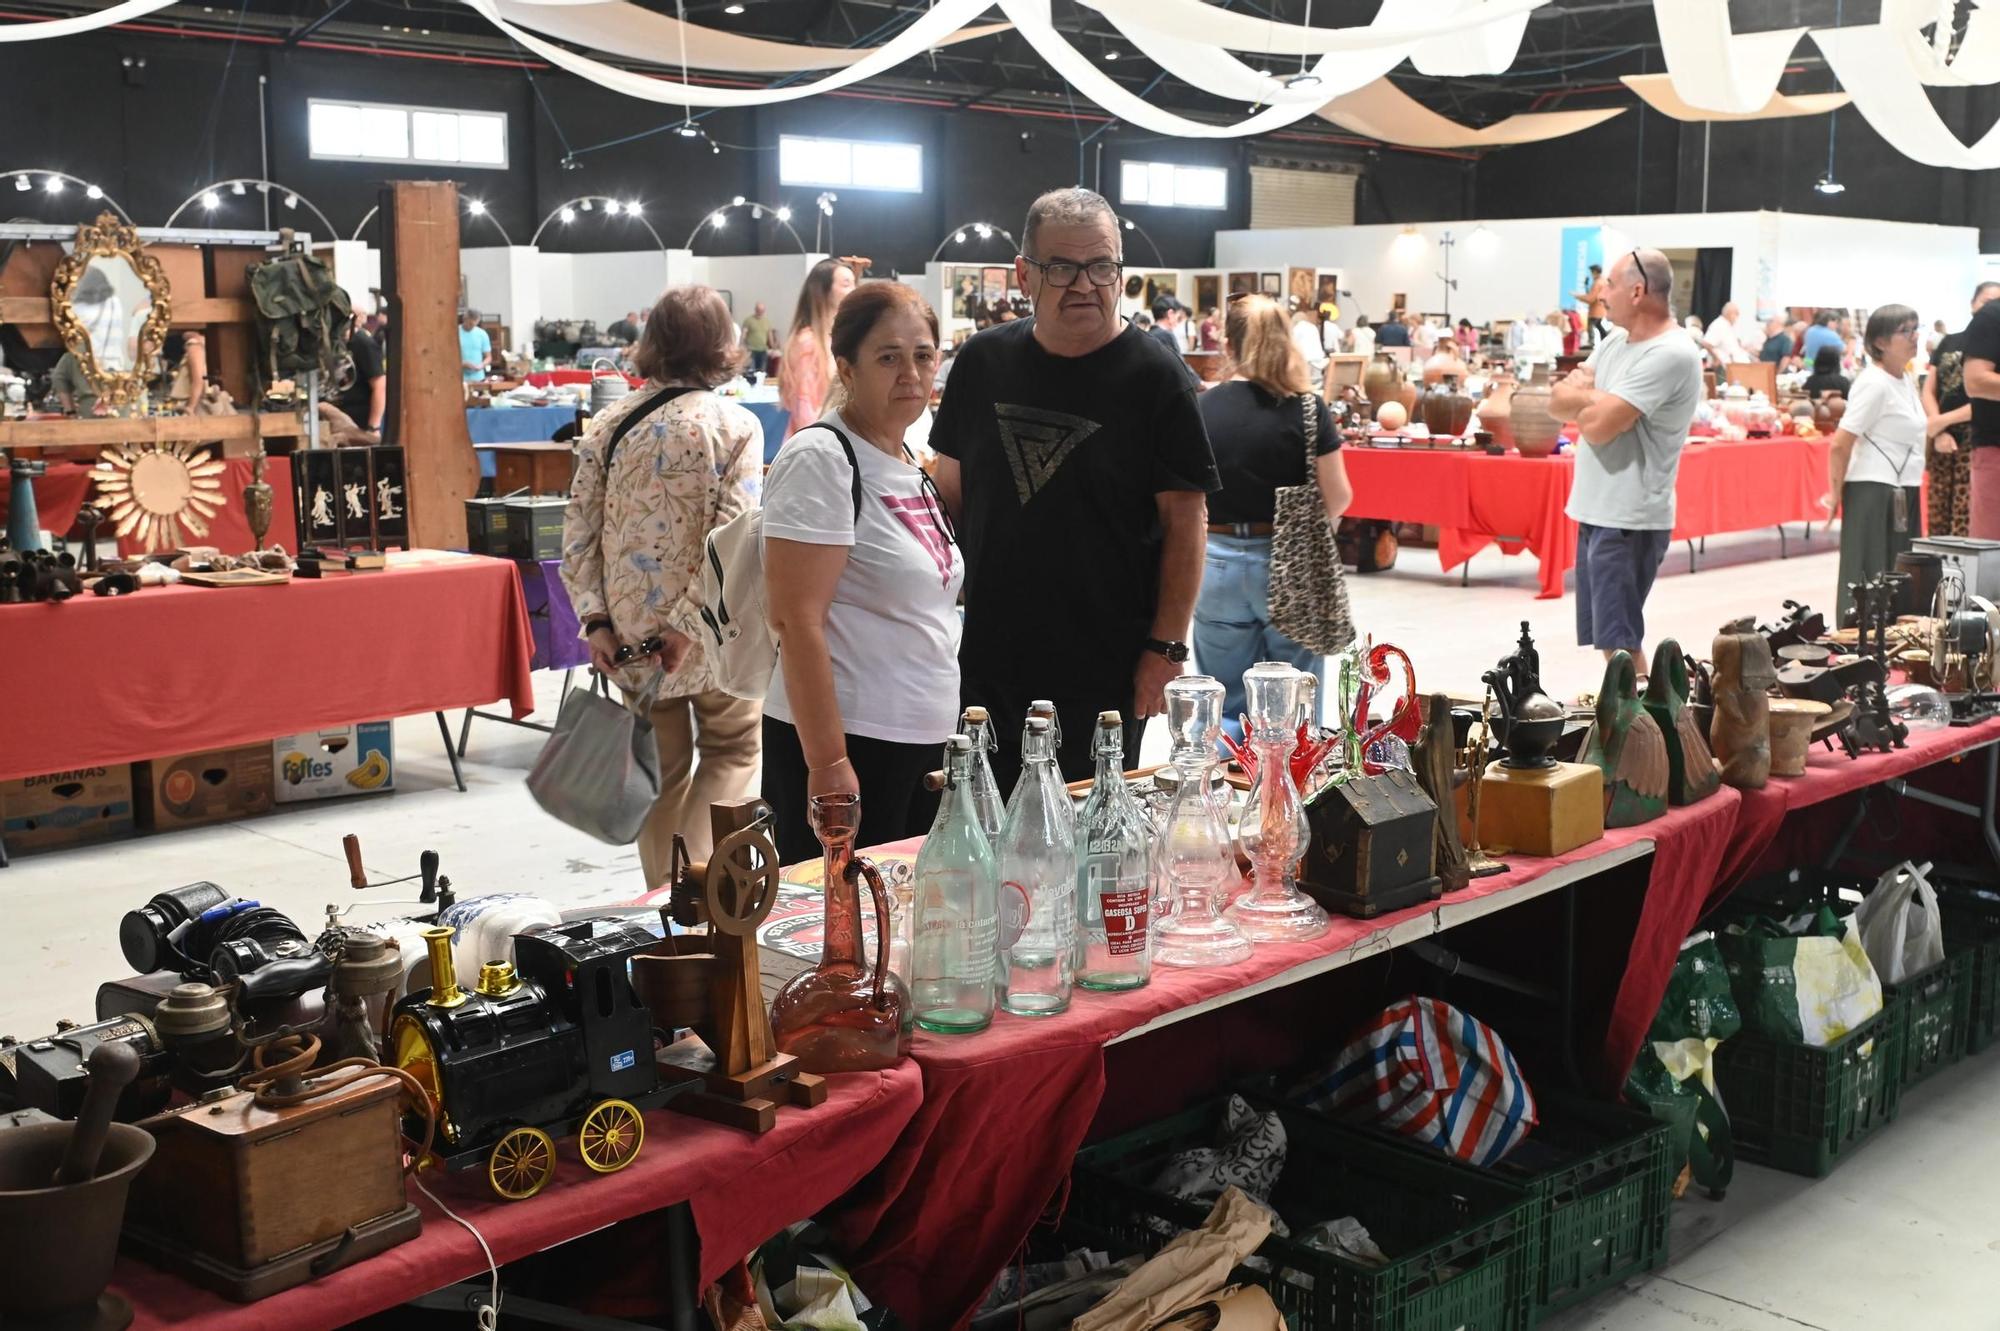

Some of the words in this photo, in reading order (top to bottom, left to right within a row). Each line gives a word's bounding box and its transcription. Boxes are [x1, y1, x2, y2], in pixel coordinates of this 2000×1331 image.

[24, 766, 107, 788] BANANAS
[1104, 907, 1133, 917] GASEOSA
[1125, 915, 1136, 931] D
